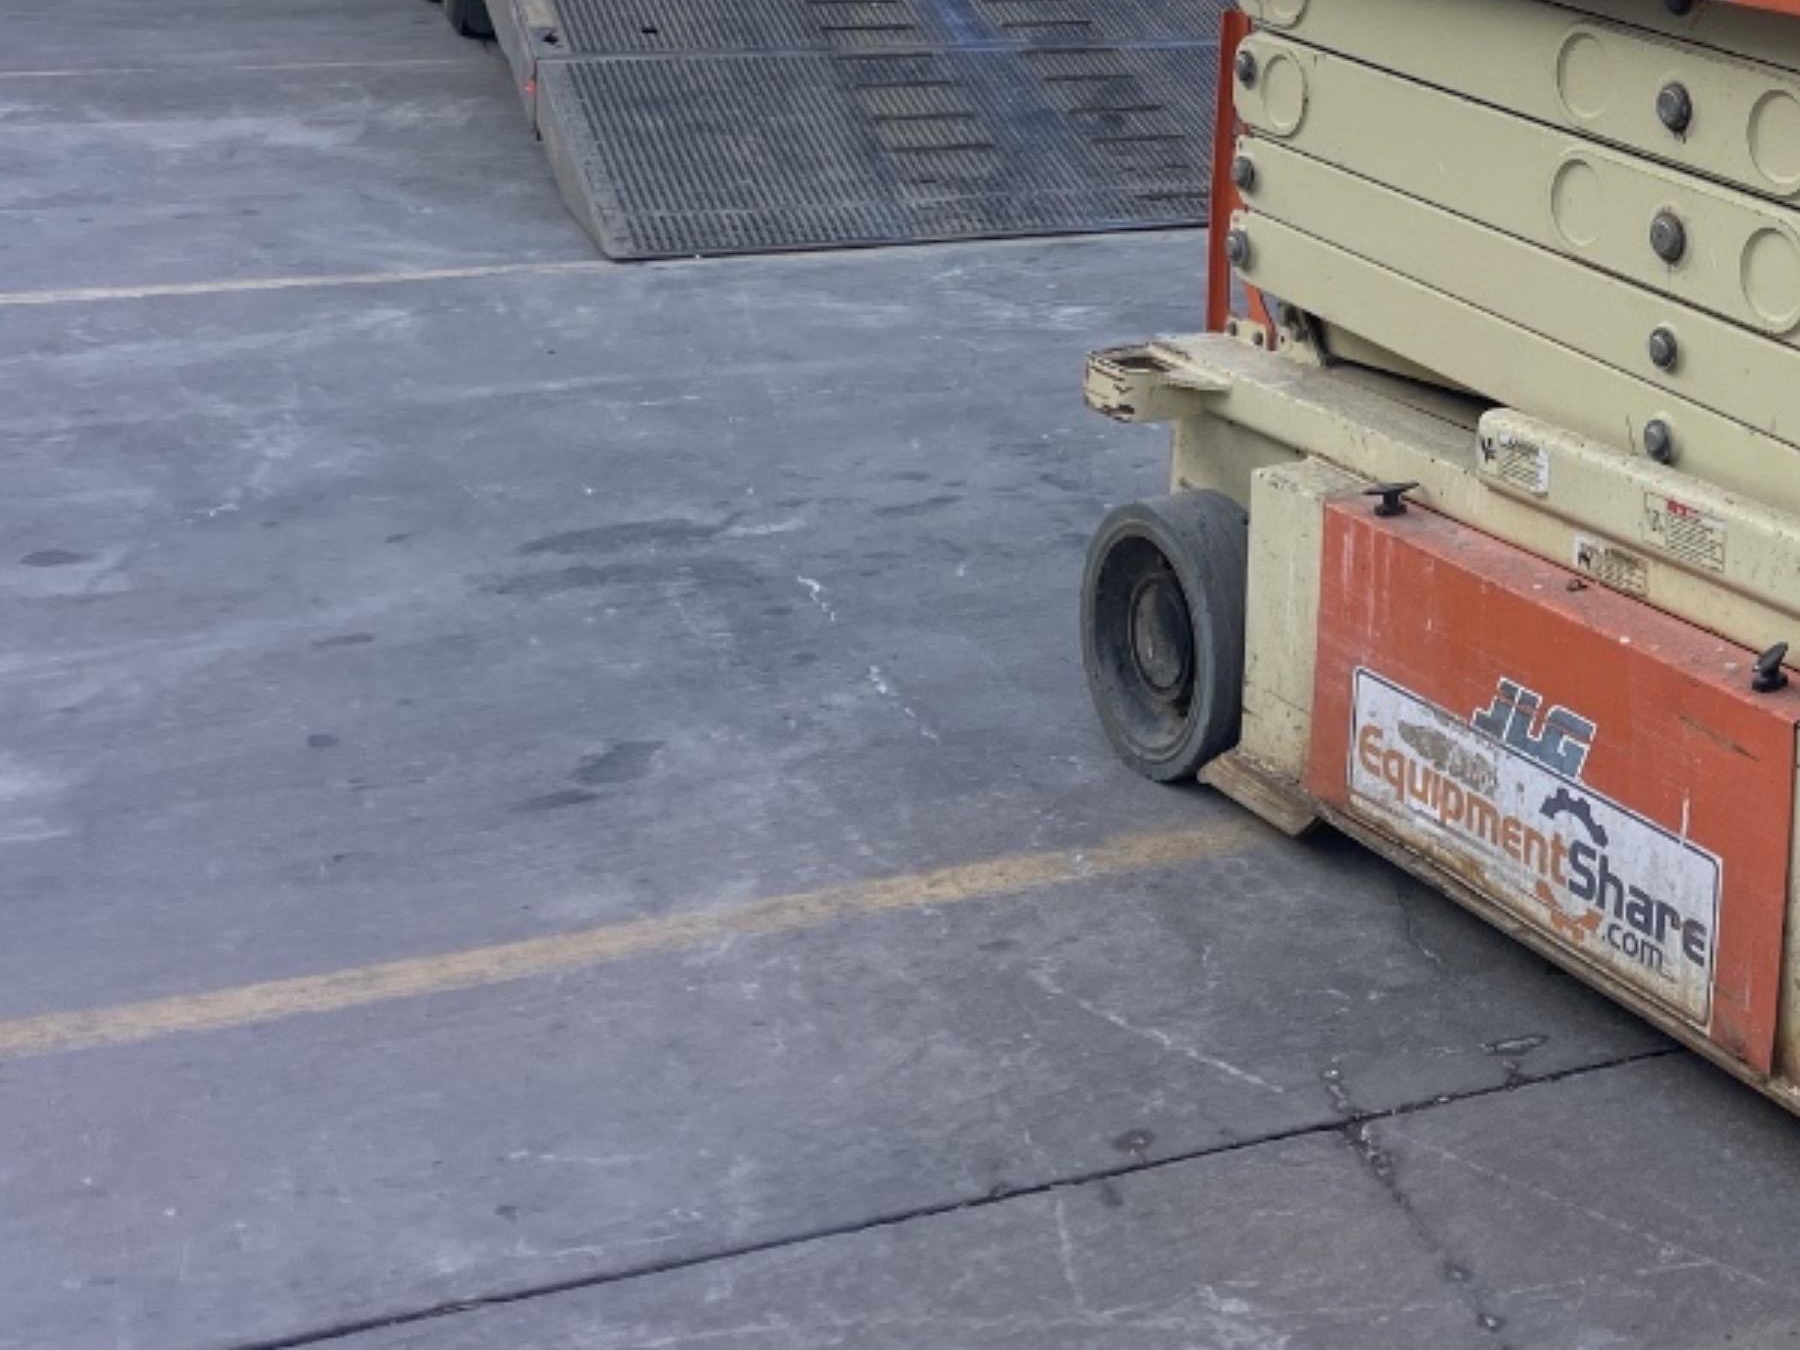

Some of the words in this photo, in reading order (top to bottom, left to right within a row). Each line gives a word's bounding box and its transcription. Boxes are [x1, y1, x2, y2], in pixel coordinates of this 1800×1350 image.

[1470, 676, 1597, 785] JLG
[1358, 723, 1706, 968] EquipmentShare
[1601, 922, 1663, 971] .com
